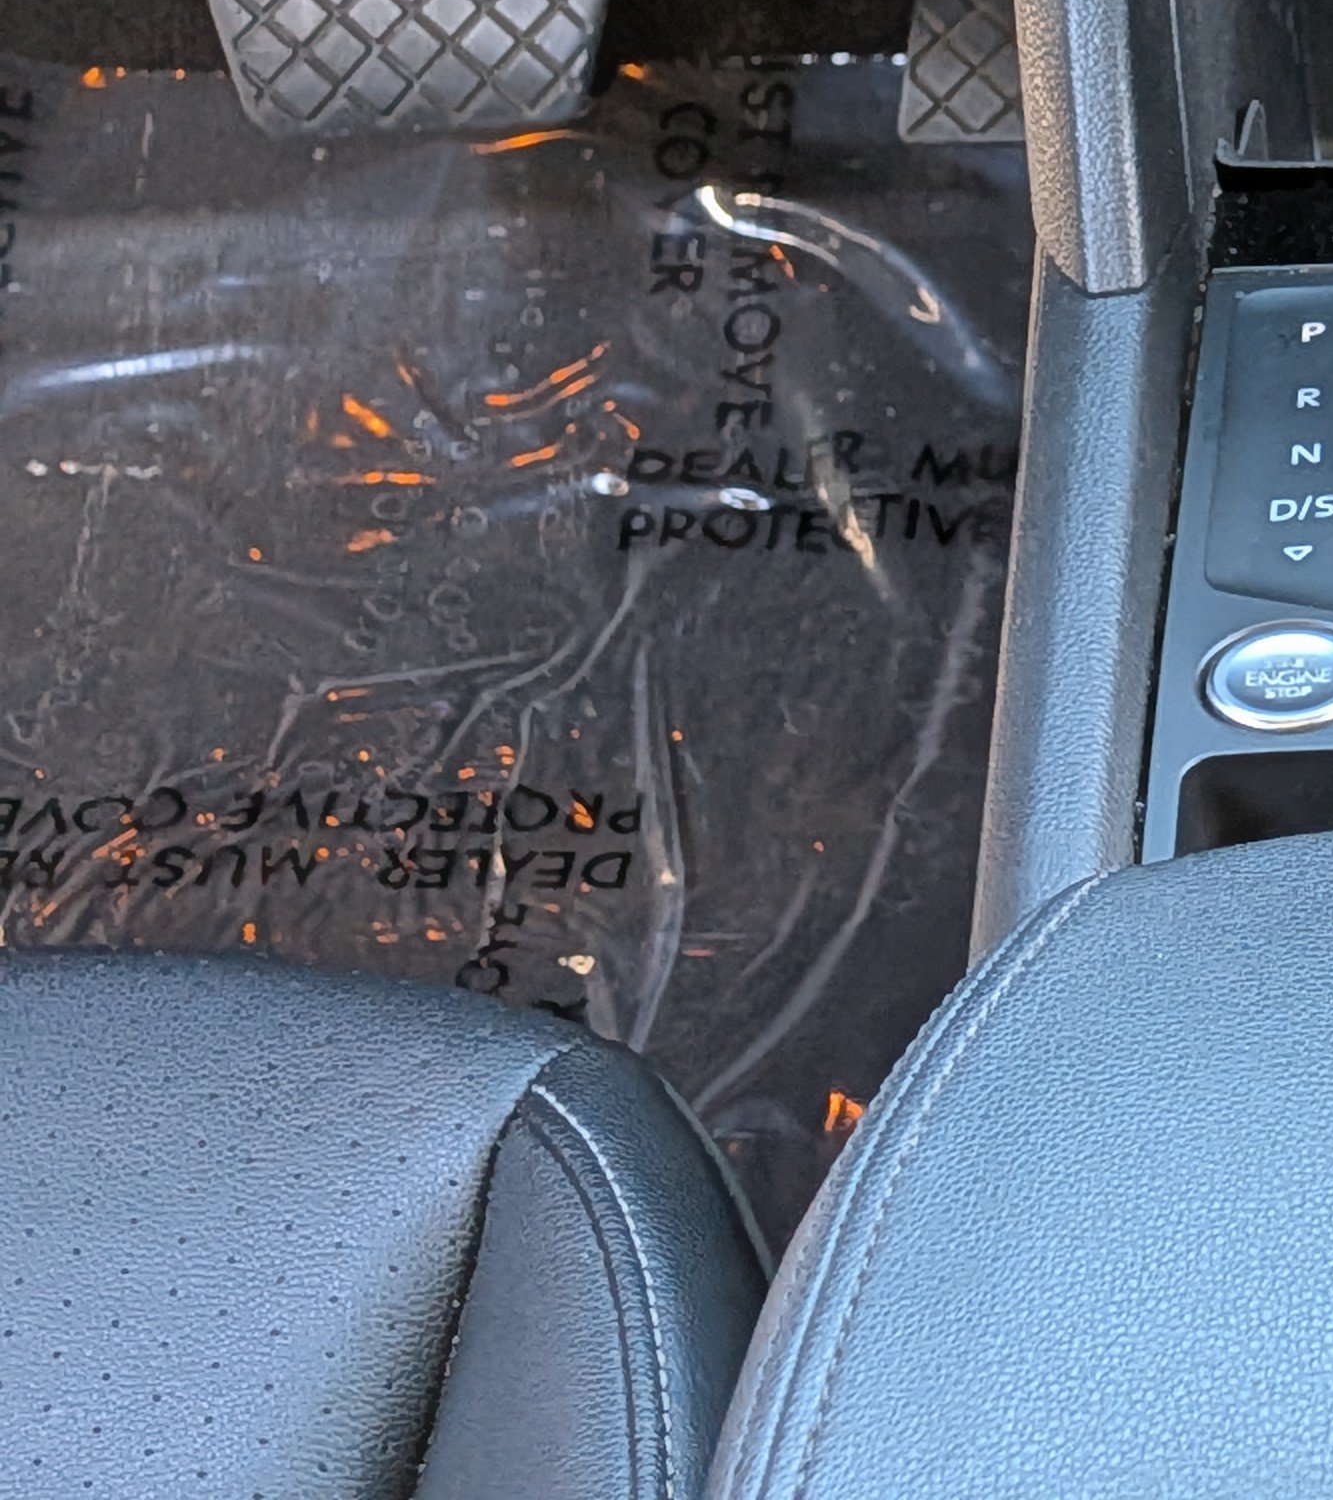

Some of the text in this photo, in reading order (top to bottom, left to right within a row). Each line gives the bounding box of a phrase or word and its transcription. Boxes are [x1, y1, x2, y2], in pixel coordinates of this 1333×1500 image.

[1300, 321, 1327, 343] P
[1296, 386, 1321, 409] R
[1290, 442, 1322, 465] N
[1245, 666, 1333, 687] ENGINE
